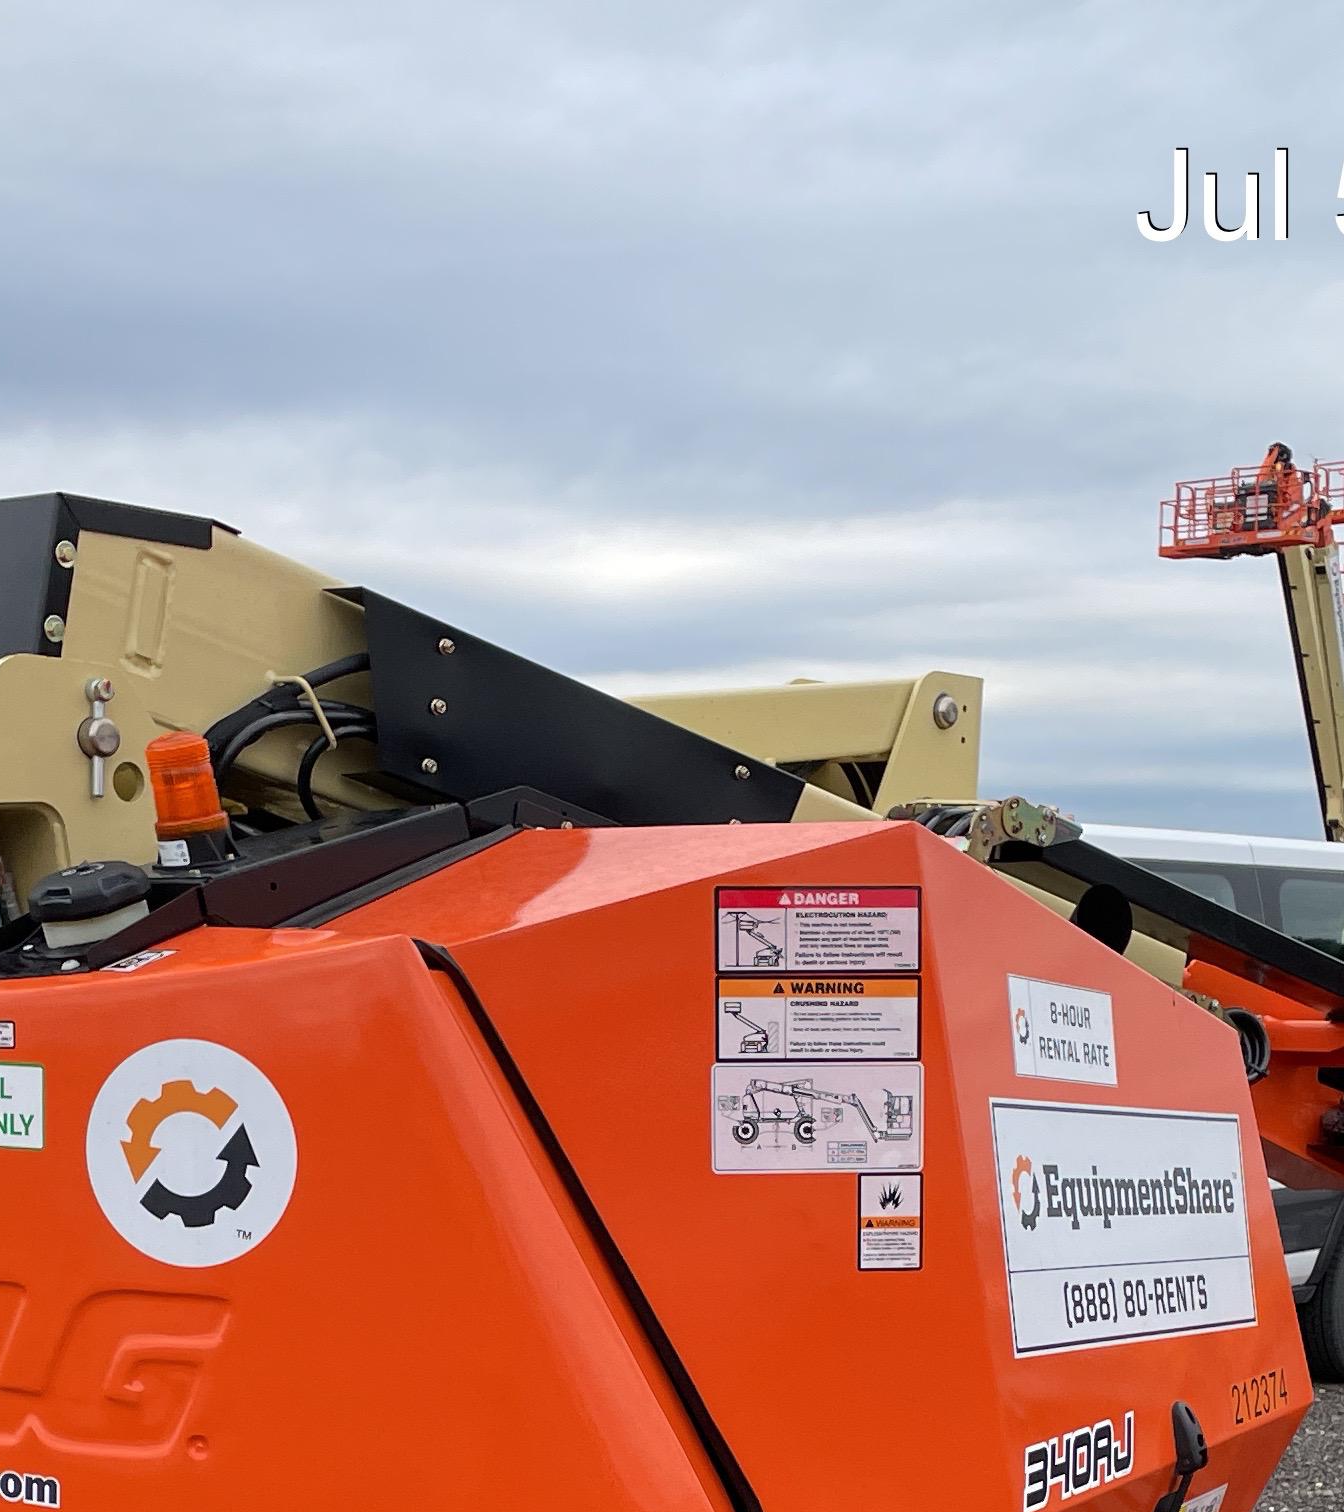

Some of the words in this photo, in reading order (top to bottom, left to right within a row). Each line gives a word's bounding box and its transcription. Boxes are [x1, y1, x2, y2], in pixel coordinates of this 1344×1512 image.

[794, 892, 860, 905] DANGER
[790, 981, 865, 995] WARNING
[1050, 1002, 1092, 1030] 8-HOUR
[1039, 1036, 1081, 1064] RENTAL
[1083, 1043, 1110, 1067] RATE
[1042, 1164, 1236, 1230] EquipmentShare
[876, 1219, 916, 1227] WARNING
[1063, 1277, 1118, 1329] (888)
[1123, 1273, 1208, 1319] 80-RENTS
[1231, 1367, 1289, 1426] 212374
[1024, 1413, 1134, 1512] 340AJ
